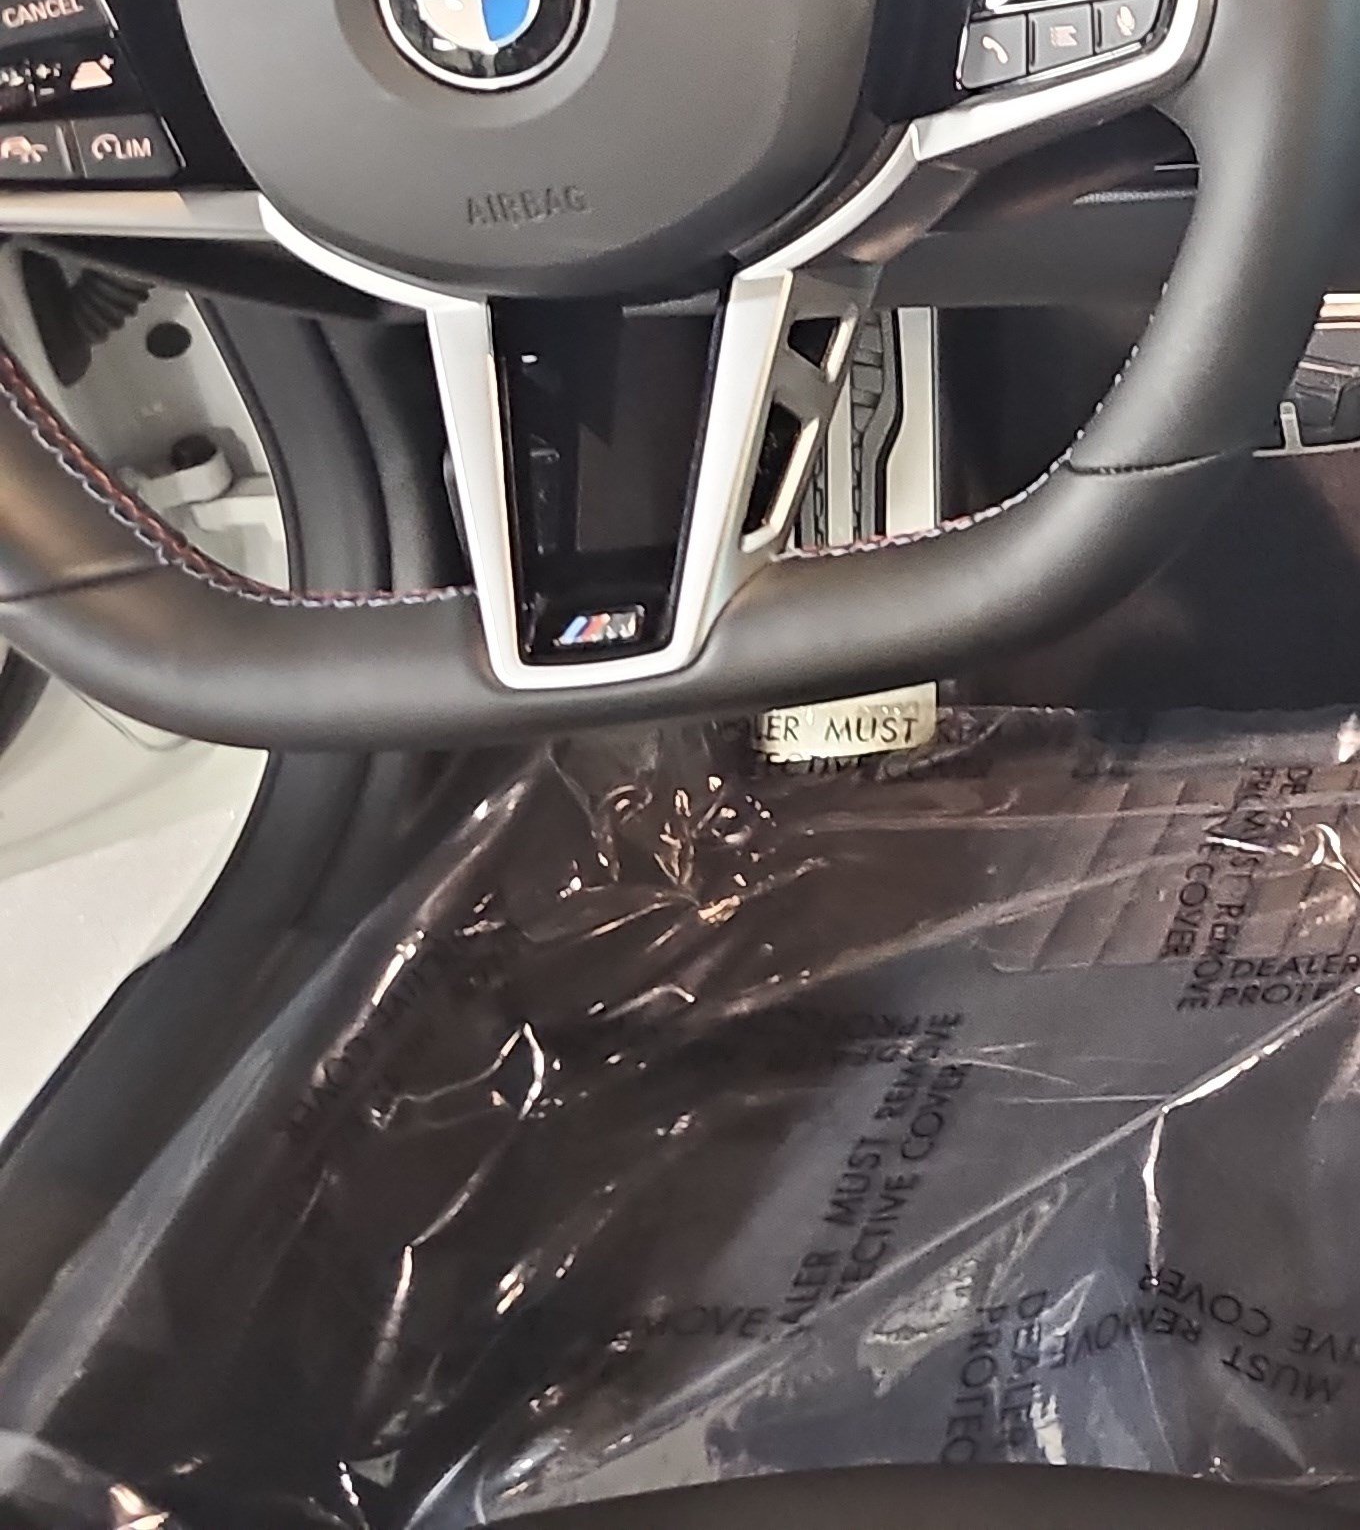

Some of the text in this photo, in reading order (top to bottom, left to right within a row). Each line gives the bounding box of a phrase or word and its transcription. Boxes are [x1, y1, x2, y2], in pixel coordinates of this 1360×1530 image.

[465, 182, 592, 228] AIRBAG
[824, 716, 919, 745] MUST
[899, 1062, 973, 1162] COVER
[823, 1135, 892, 1228] MUST
[1220, 1342, 1343, 1405] MUST
